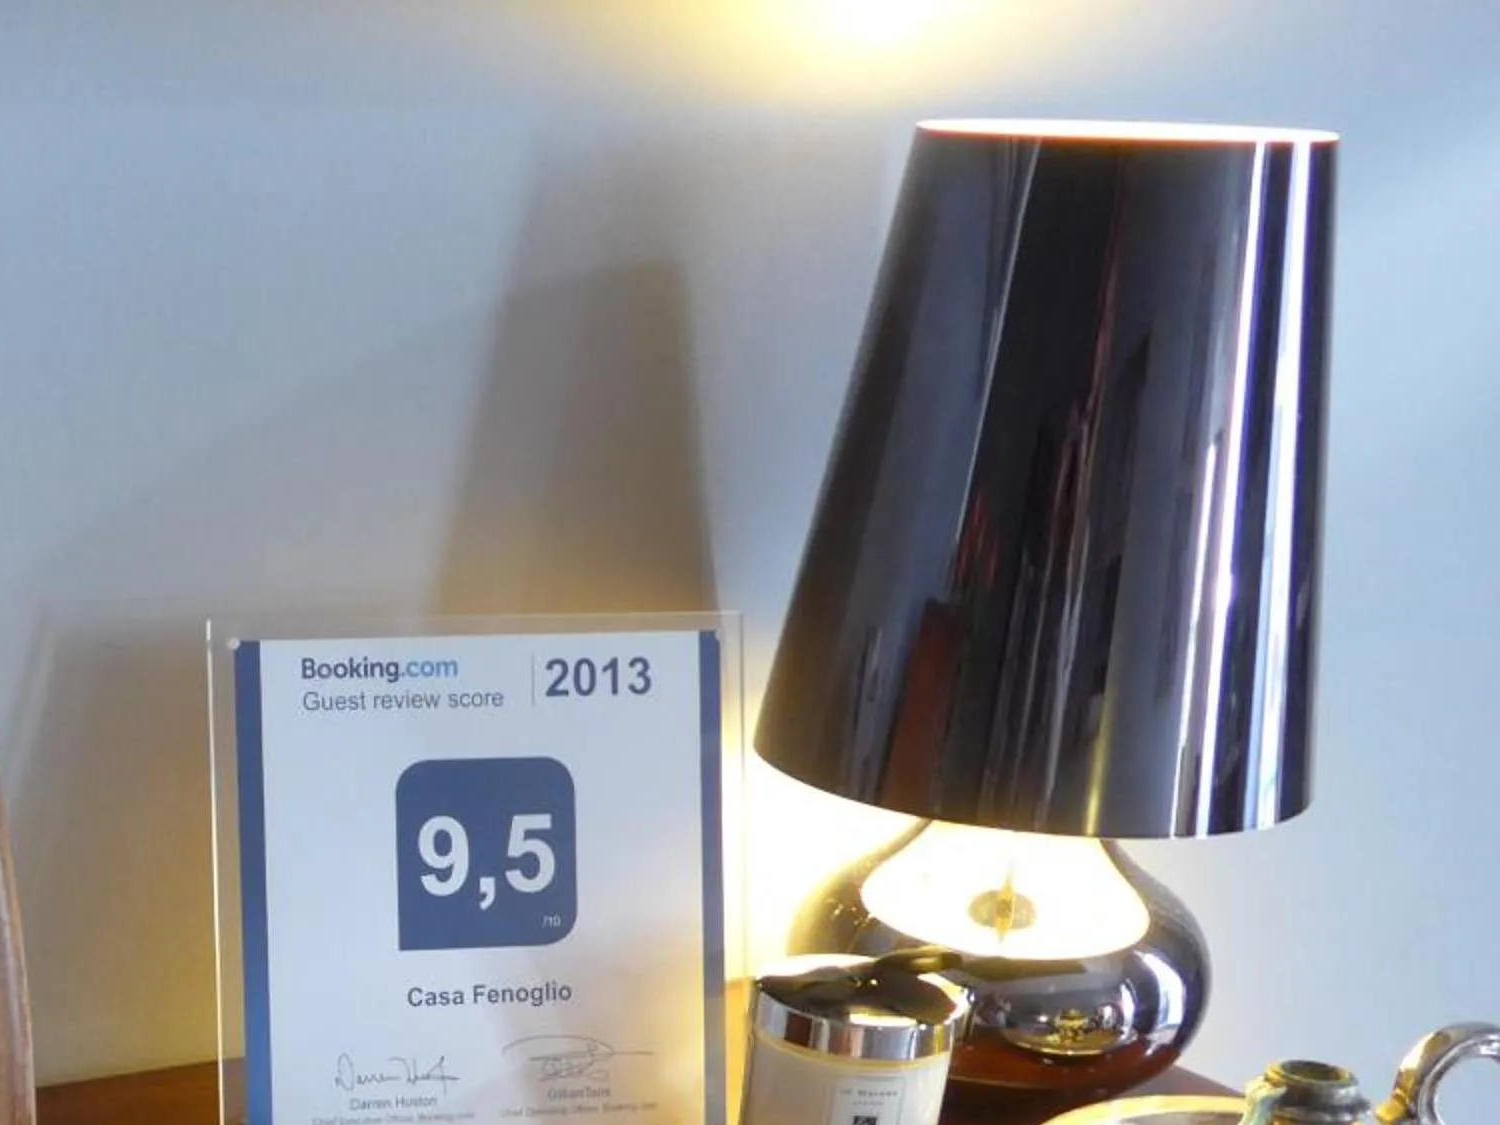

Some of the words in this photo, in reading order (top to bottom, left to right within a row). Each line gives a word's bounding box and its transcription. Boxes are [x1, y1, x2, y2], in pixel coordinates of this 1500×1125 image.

[301, 657, 459, 682] Booking.com
[545, 657, 652, 697] 2013
[303, 691, 366, 711] Guest
[373, 691, 441, 709] review
[449, 691, 505, 708] score
[417, 814, 557, 910] 9,5
[407, 987, 465, 1007] Casa
[472, 980, 573, 1007] Fenoglio
[350, 1098, 390, 1111] Darren
[395, 1096, 438, 1109] Huston
